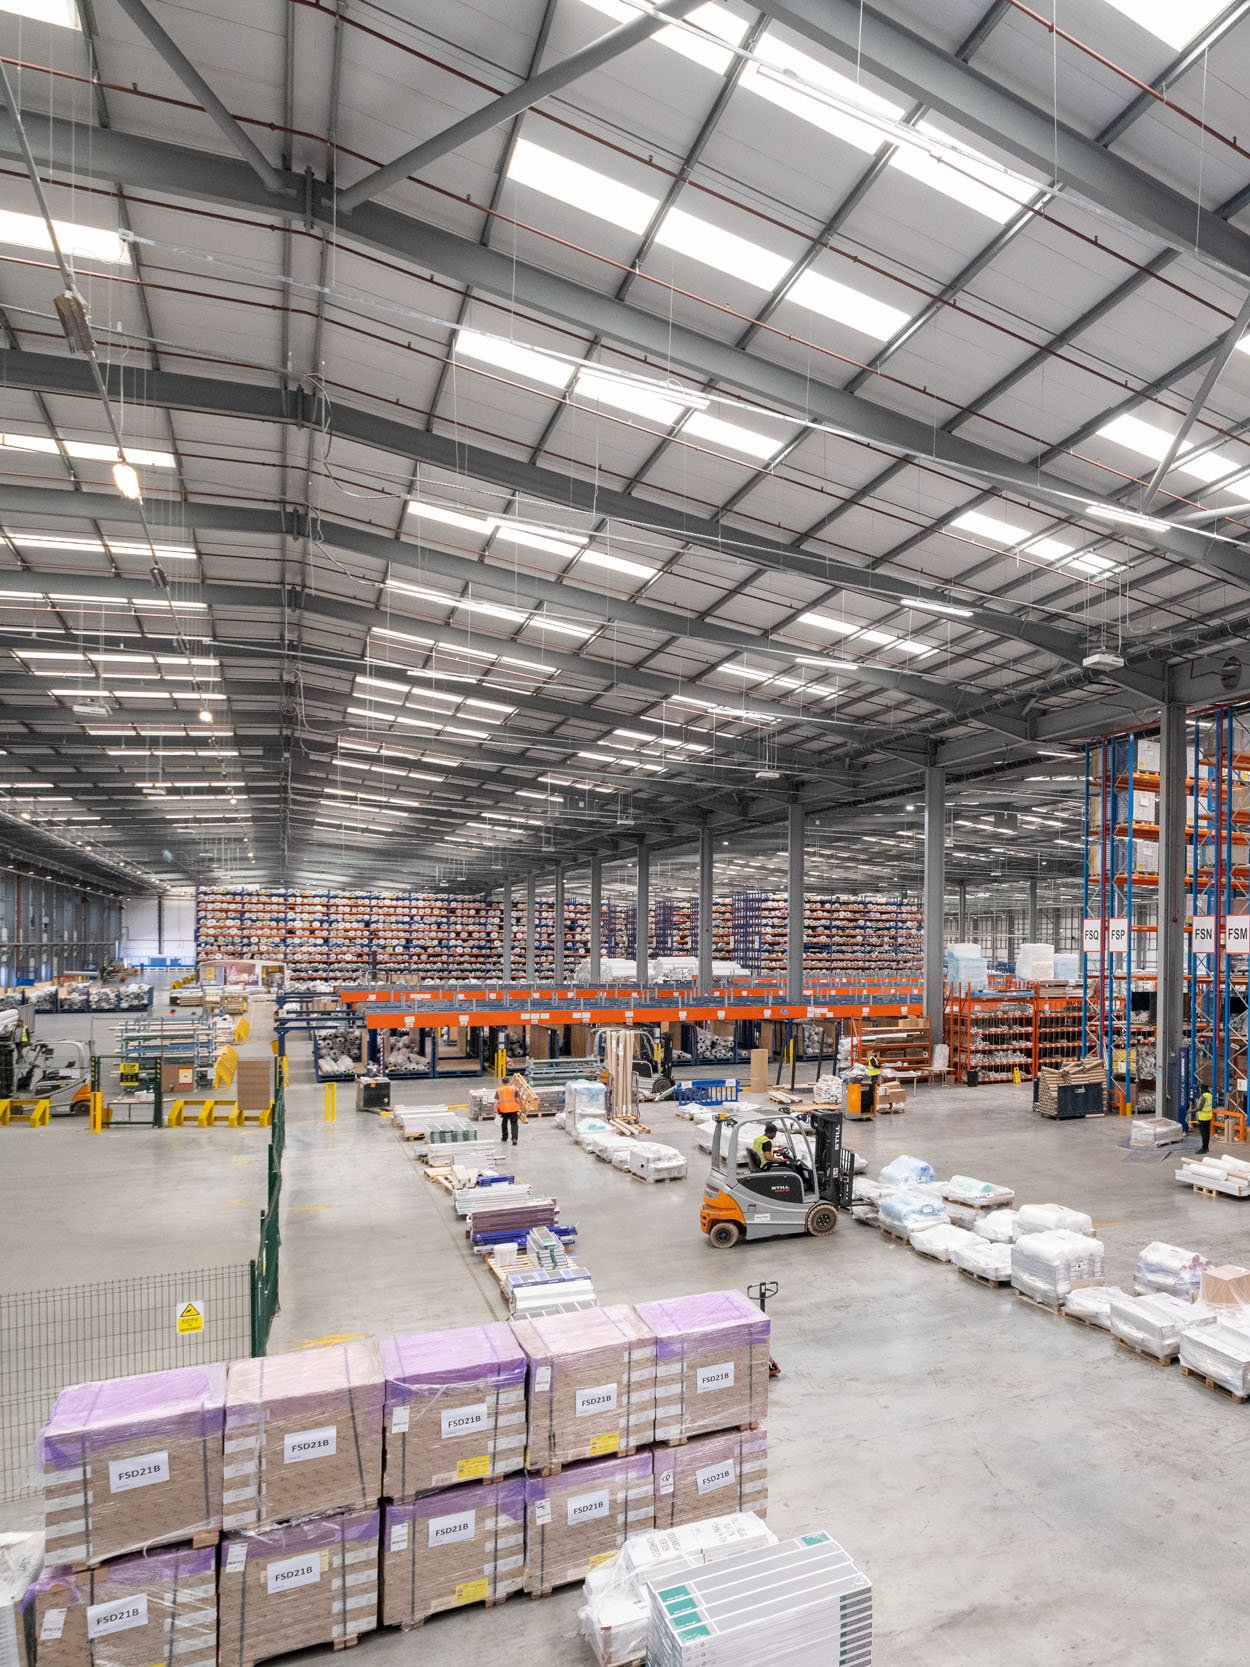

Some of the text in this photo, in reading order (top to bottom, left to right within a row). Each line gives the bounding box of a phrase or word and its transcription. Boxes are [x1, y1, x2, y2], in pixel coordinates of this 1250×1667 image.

[1084, 929, 1099, 941] FSQ
[1111, 929, 1125, 940] FSP
[1194, 928, 1213, 940] FSN
[1228, 927, 1248, 940] FSM
[702, 1372, 730, 1385] FSD21B
[581, 1394, 612, 1408] FSD21B
[447, 1414, 482, 1429] FSD21B
[291, 1437, 330, 1453] FSD21B
[117, 1463, 162, 1481] FSD21B
[702, 1469, 730, 1486] FSD21B
[573, 1500, 605, 1515] FSD21B
[435, 1522, 470, 1537] FSD21B
[274, 1565, 314, 1583] FSD21B
[95, 1607, 140, 1627] FSD21B
